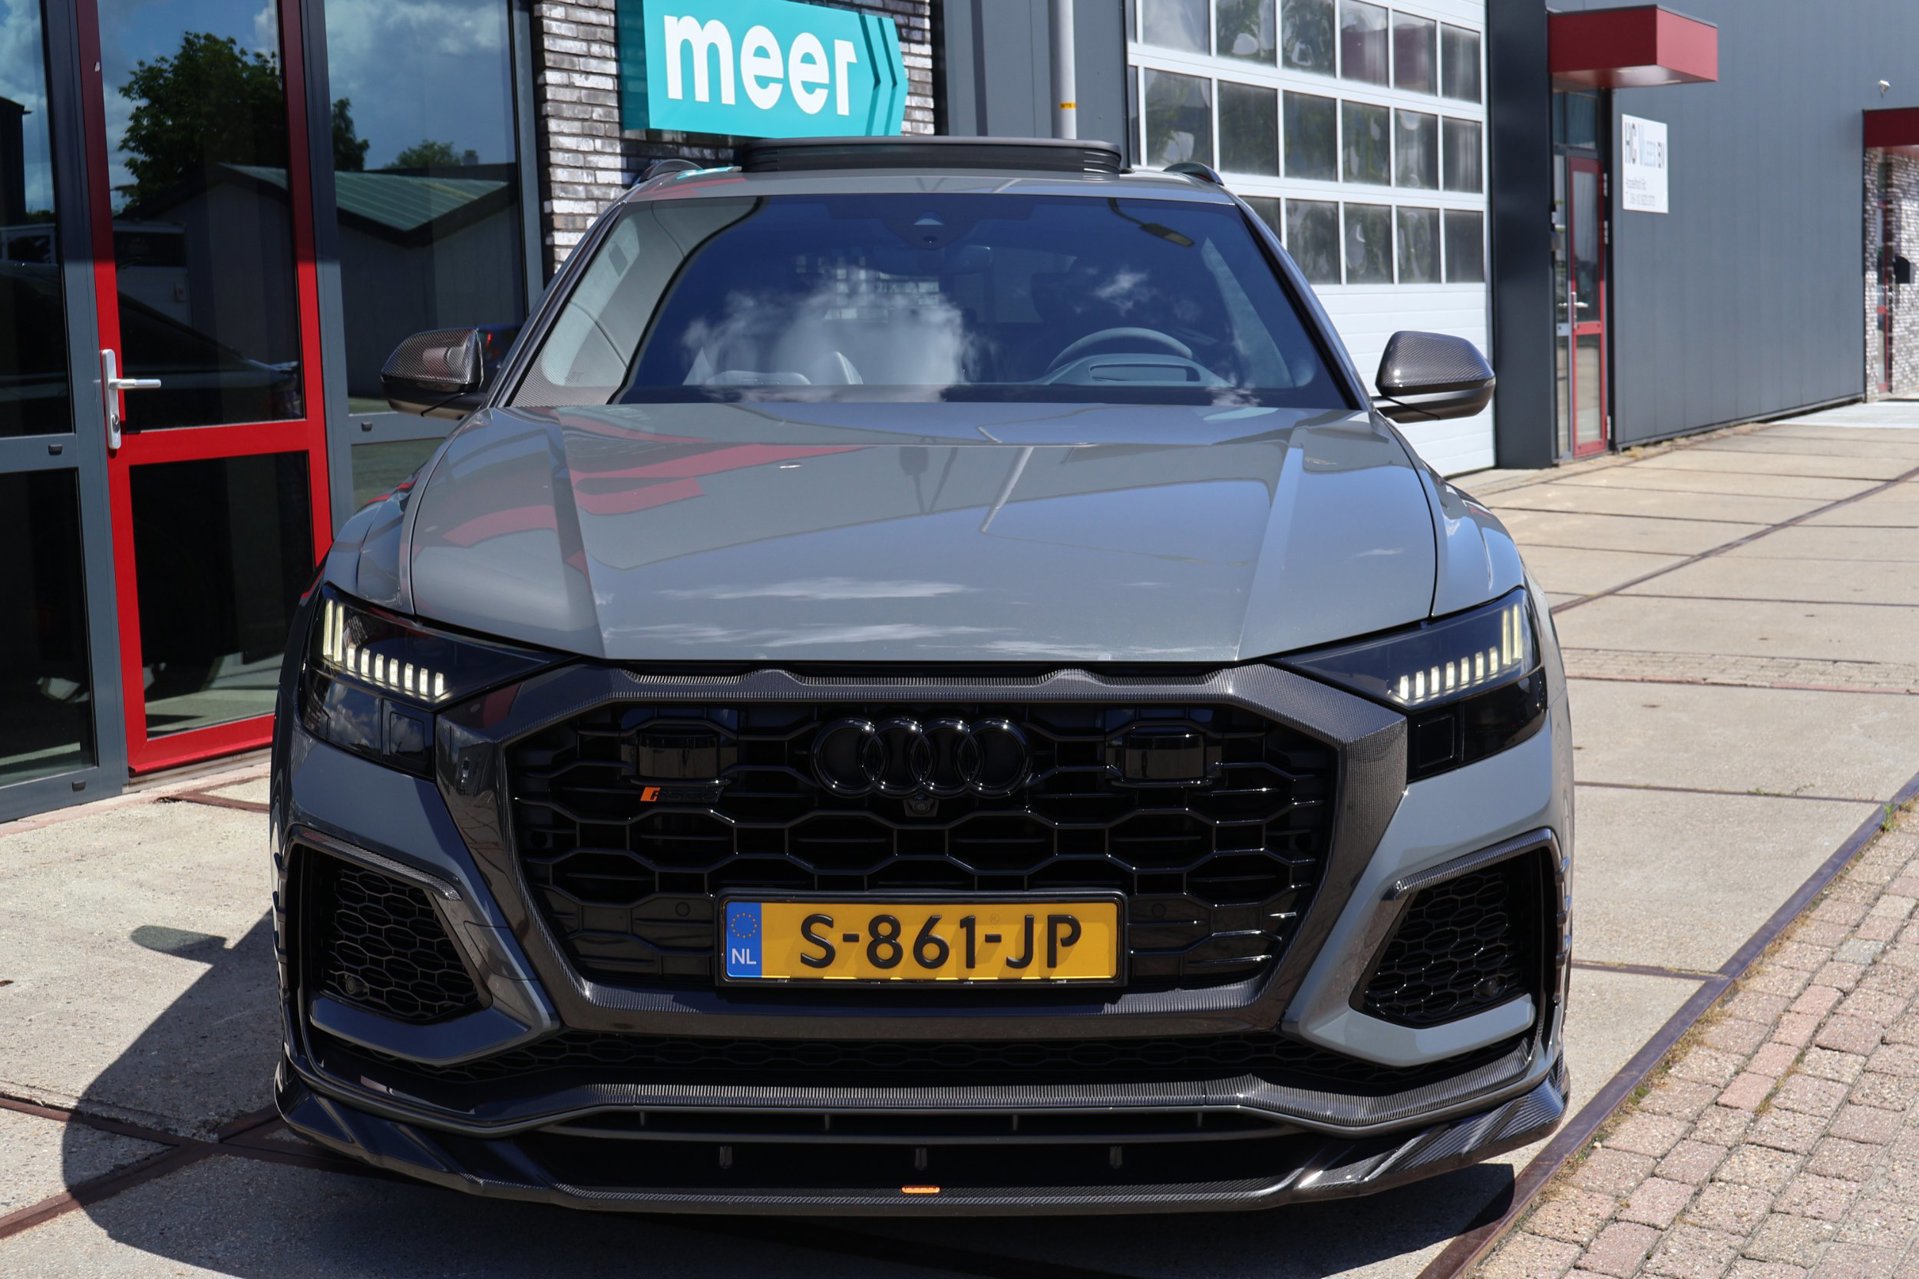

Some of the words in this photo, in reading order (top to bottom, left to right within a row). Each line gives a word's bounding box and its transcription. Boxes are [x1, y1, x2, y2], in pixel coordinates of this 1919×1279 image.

[663, 15, 858, 116] meer
[731, 948, 757, 965] NL
[800, 913, 1082, 969] S-861-JP
